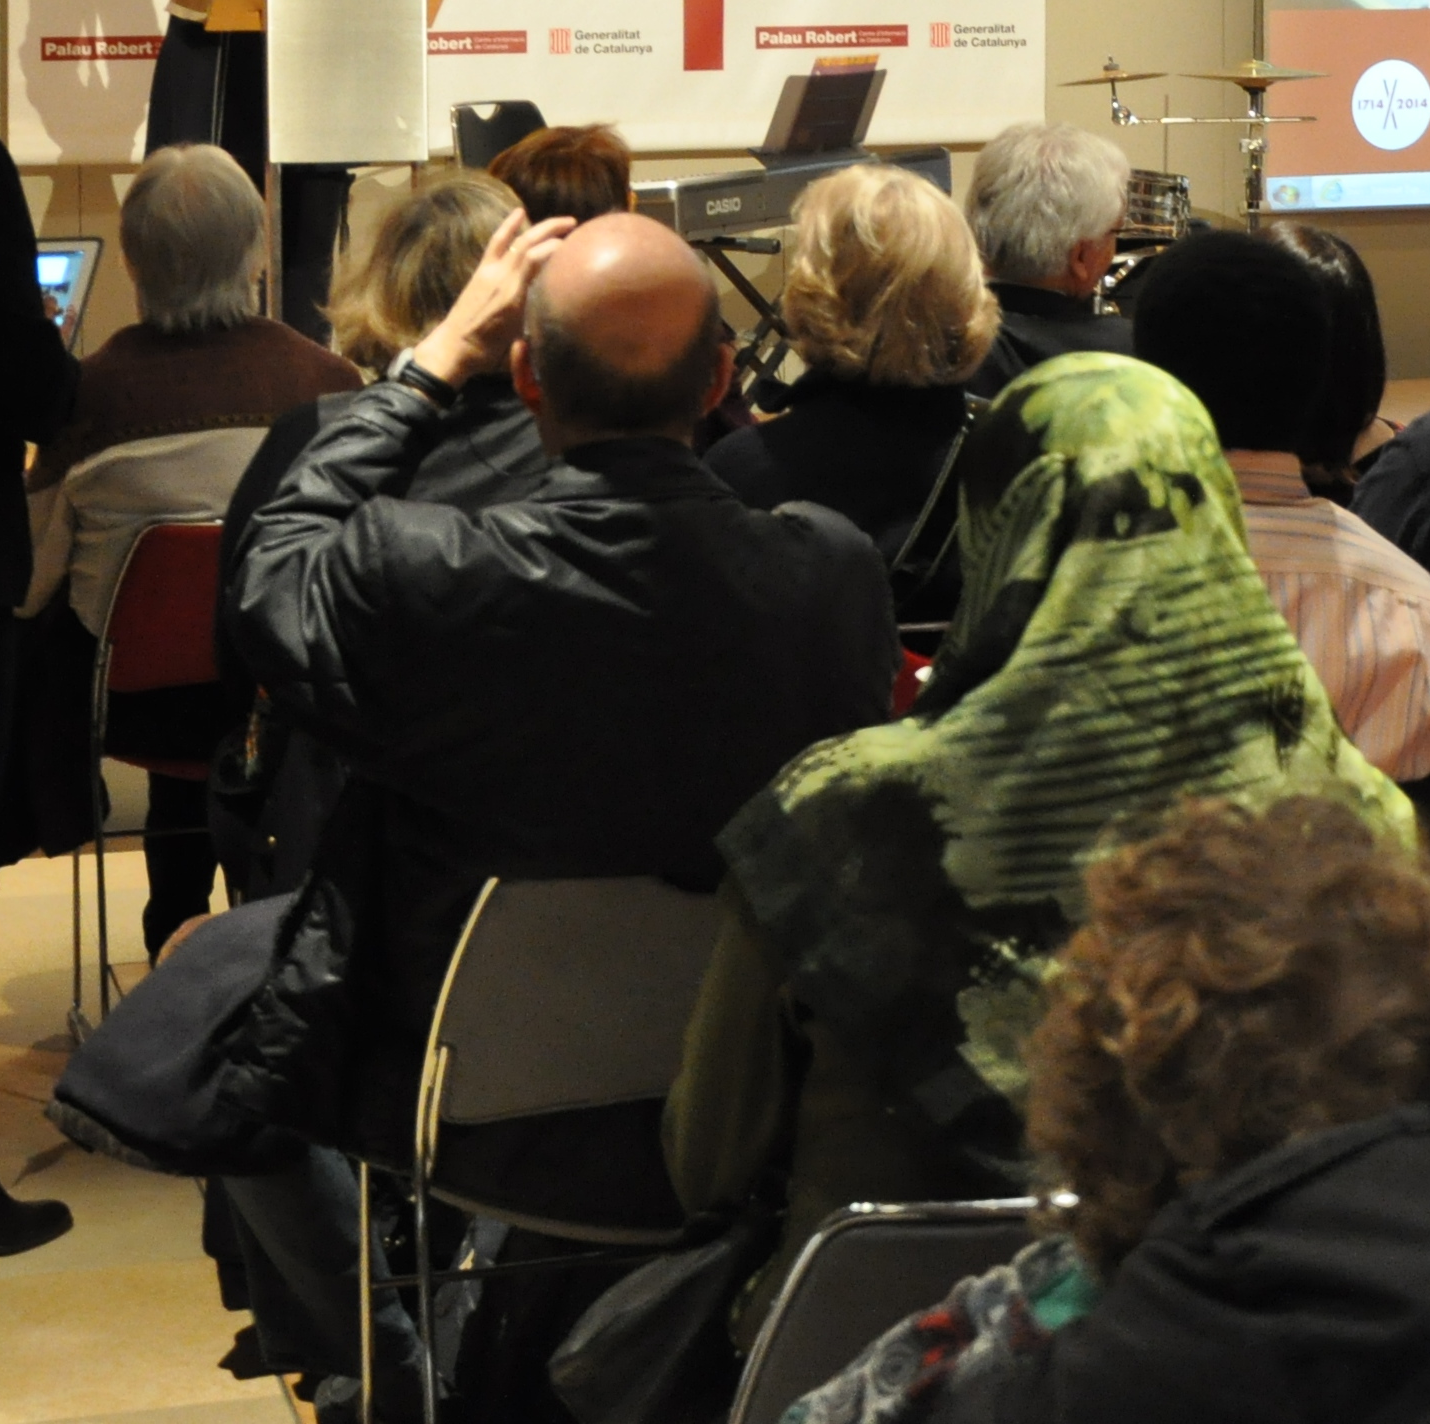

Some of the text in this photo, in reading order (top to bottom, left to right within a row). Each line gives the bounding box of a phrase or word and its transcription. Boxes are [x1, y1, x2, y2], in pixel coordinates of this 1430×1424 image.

[954, 24, 1016, 36] Generalitat
[575, 31, 640, 42] Generalitat
[759, 31, 802, 45] Palau
[806, 30, 857, 44] Robert
[45, 41, 153, 56] Palau Robert
[954, 38, 1027, 50] de Catalunya
[575, 44, 653, 57] de Catalunya
[1357, 98, 1428, 110] 1714 2014
[706, 197, 741, 216] CASIO
